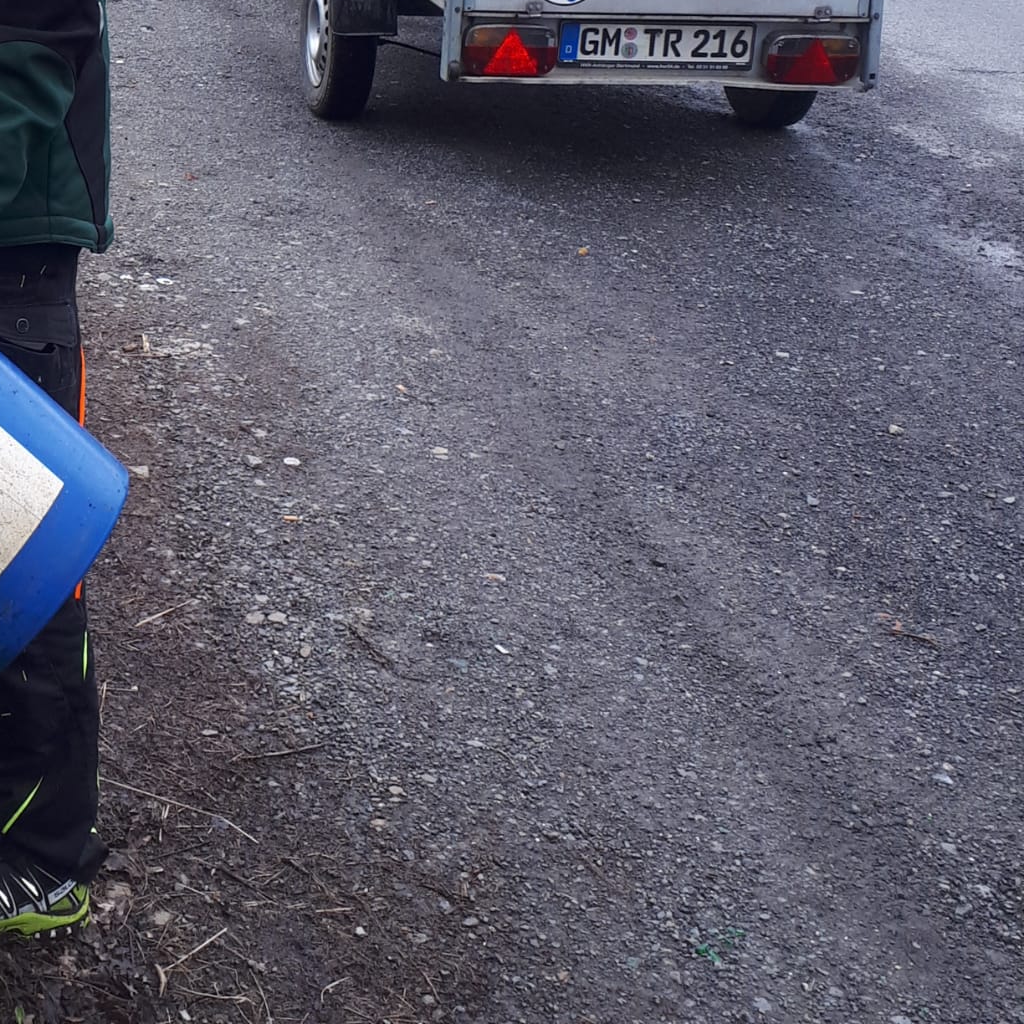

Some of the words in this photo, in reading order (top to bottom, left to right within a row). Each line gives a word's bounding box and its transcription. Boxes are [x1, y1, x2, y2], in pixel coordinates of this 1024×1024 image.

[580, 27, 622, 56] GM
[644, 29, 683, 58] TR
[691, 30, 749, 59] 216
